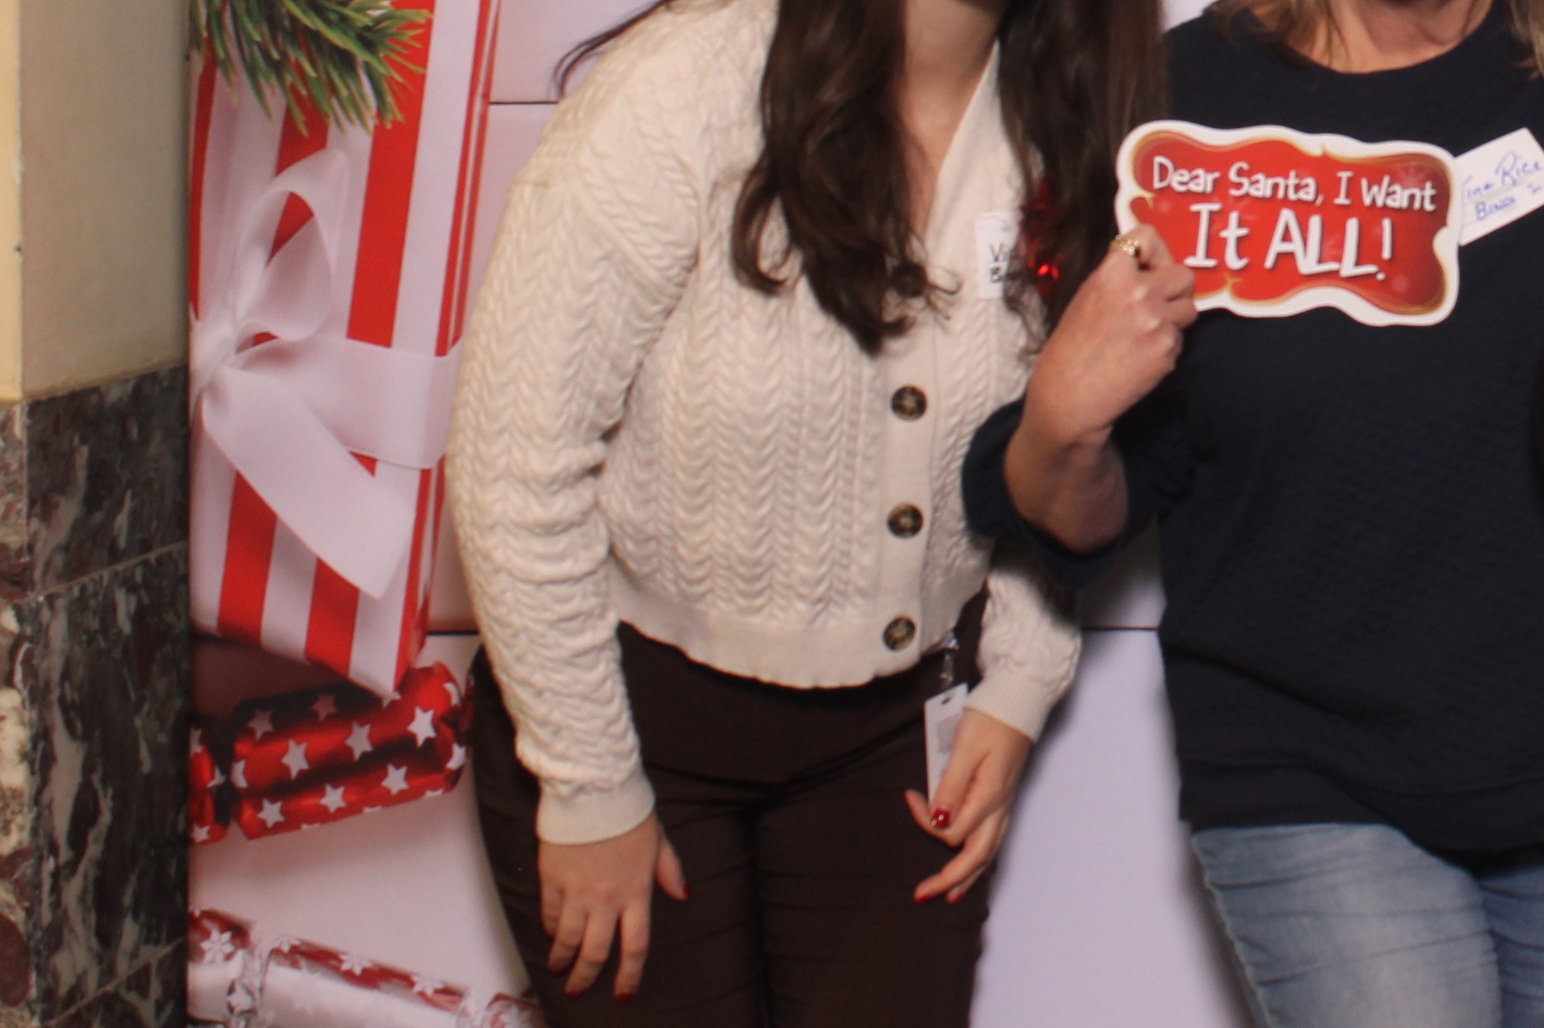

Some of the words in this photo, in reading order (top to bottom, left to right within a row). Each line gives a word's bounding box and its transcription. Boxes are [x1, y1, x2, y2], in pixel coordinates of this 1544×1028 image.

[1153, 155, 1221, 194] Dear
[1228, 161, 1324, 207] Santa,
[1333, 171, 1354, 205] I
[1360, 175, 1437, 212] Want
[1183, 202, 1250, 270] It
[1263, 208, 1393, 281] ALL!
